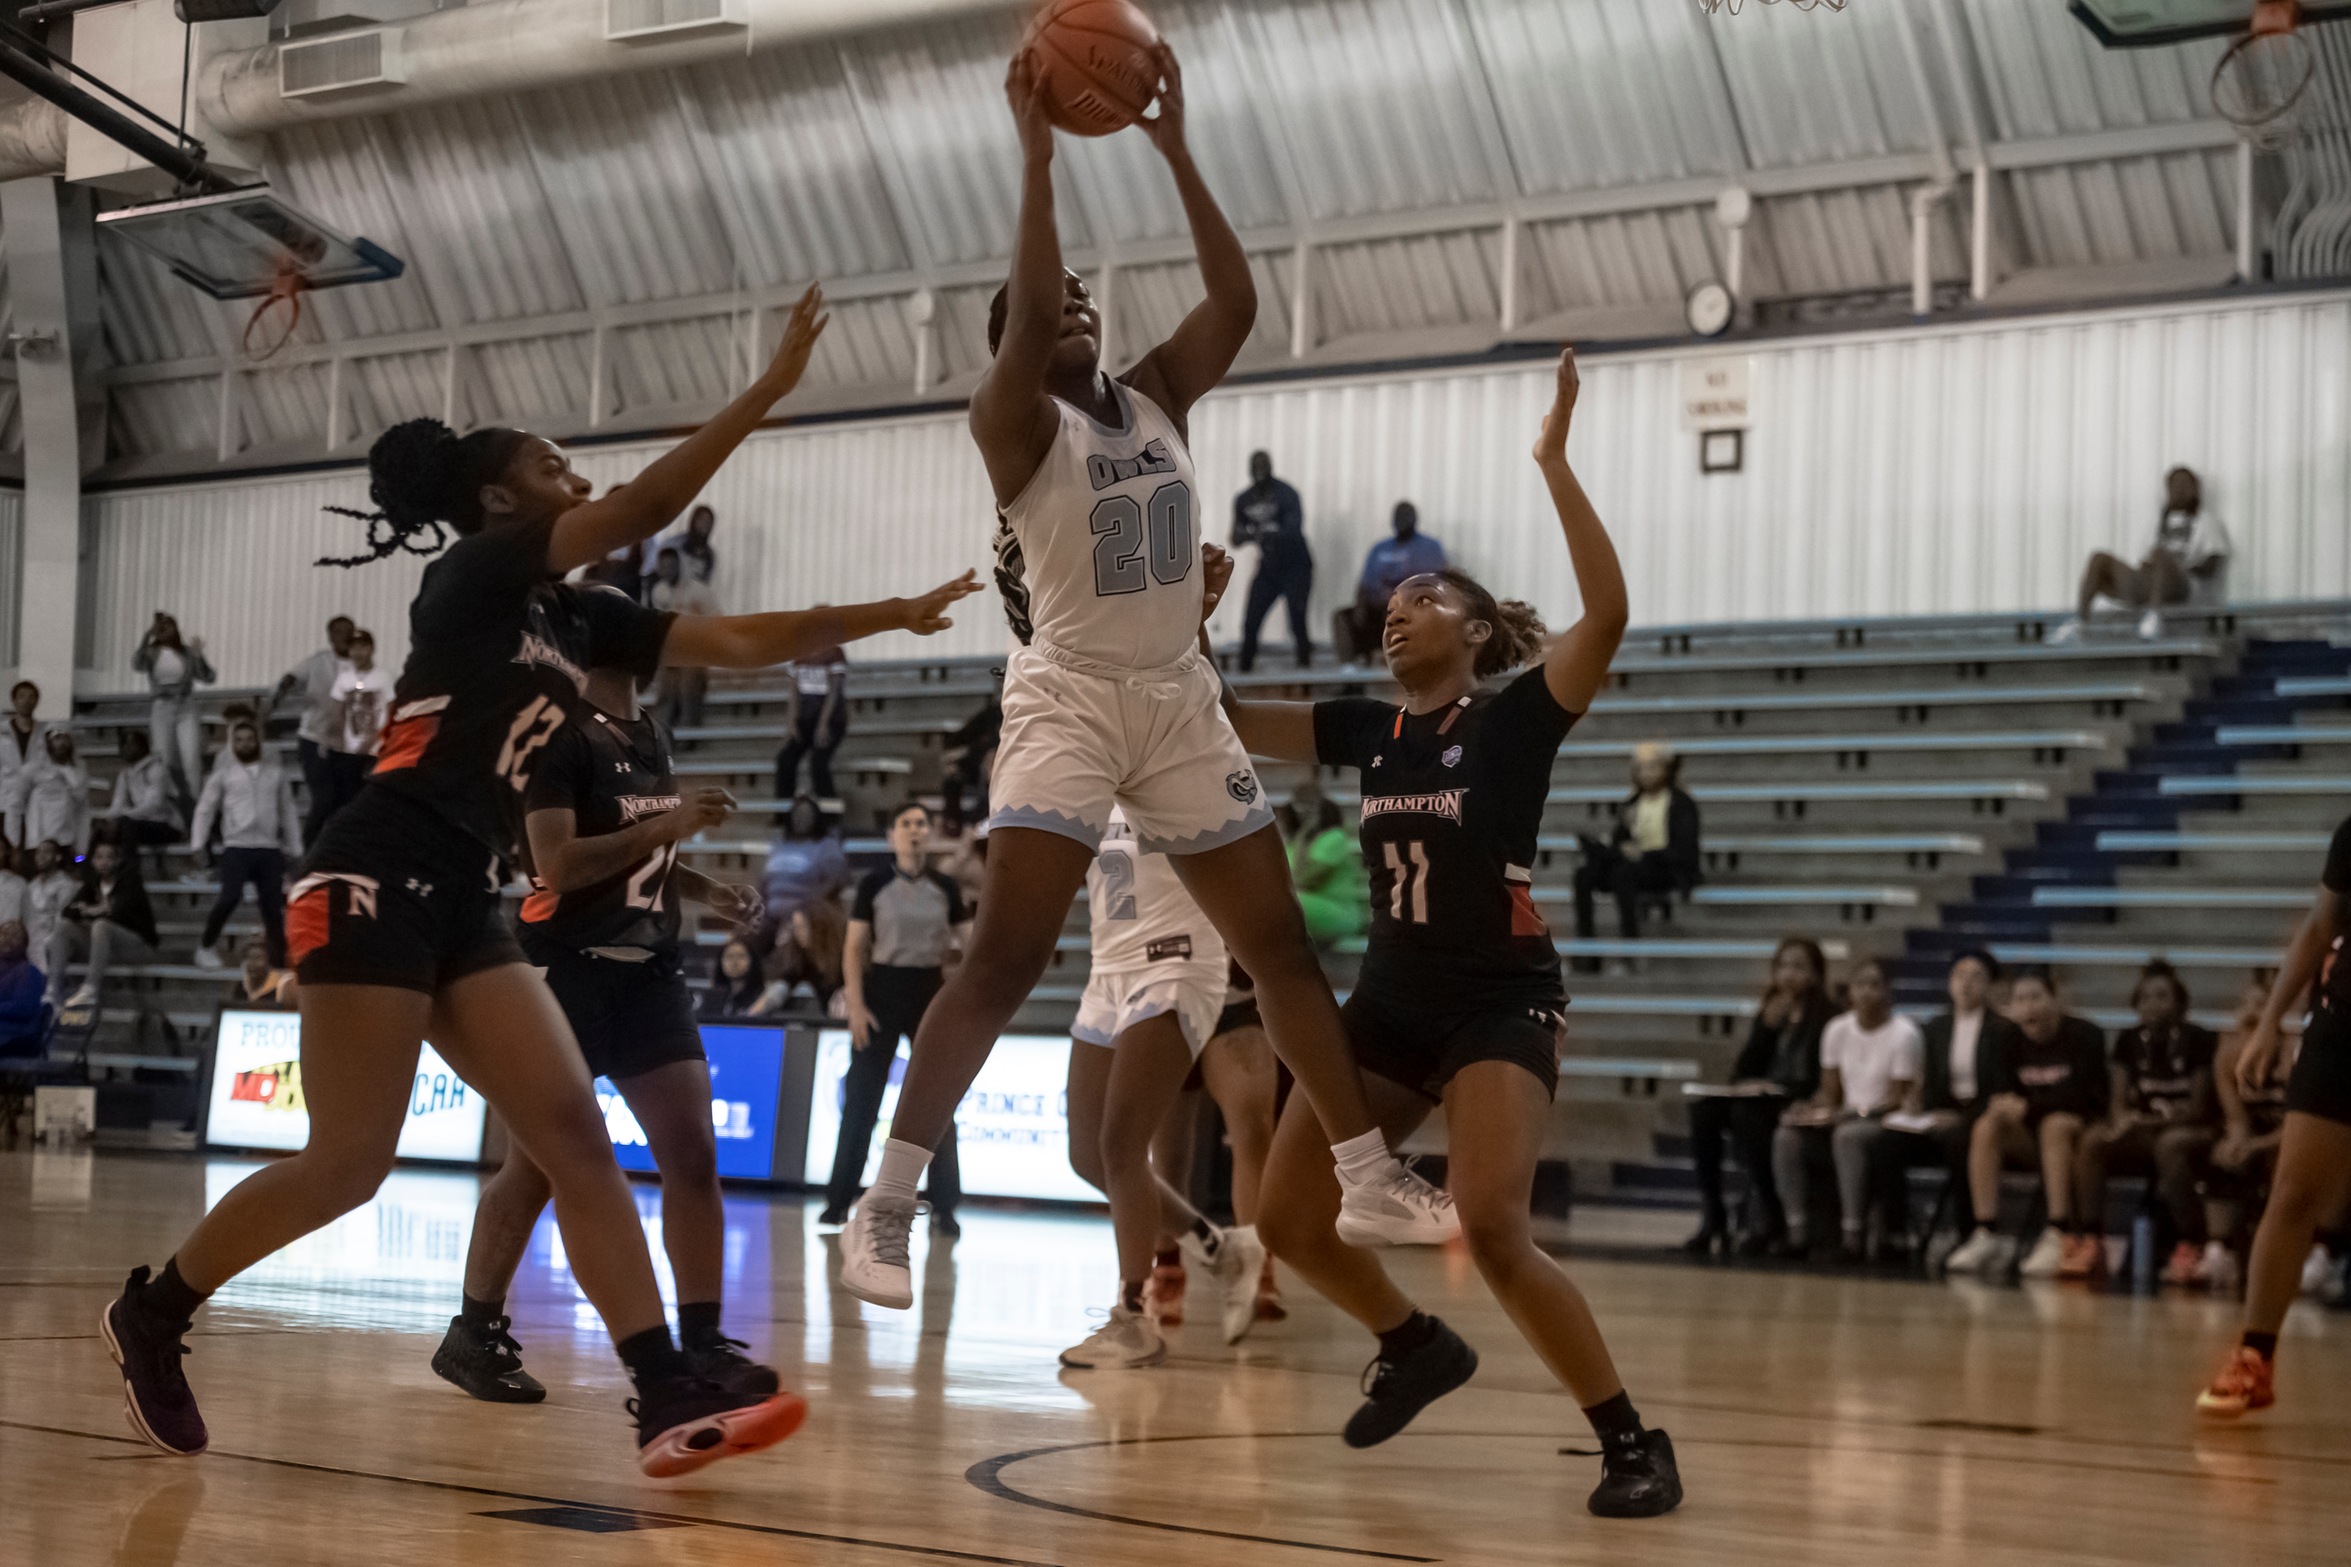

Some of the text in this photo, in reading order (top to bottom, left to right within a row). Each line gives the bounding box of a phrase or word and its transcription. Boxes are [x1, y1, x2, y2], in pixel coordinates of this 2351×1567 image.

[1087, 438, 1176, 491] OWLS
[1089, 480, 1192, 597] 20
[496, 693, 566, 792] 12
[1098, 850, 1137, 920] 2
[1382, 839, 1429, 925] 11
